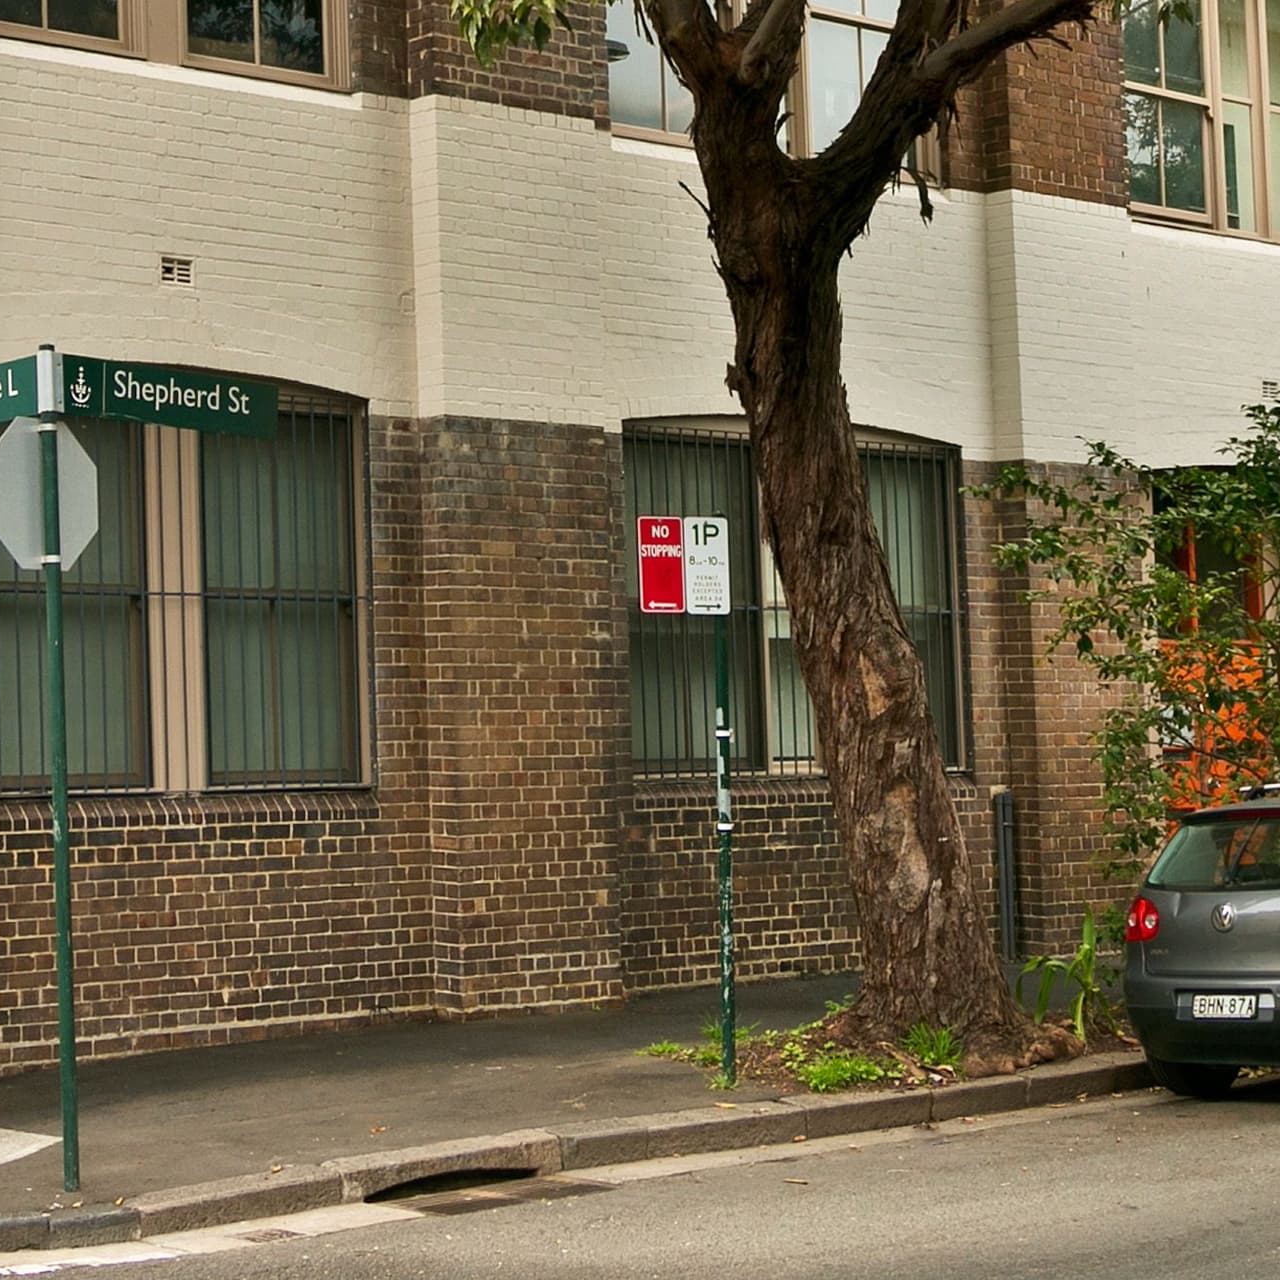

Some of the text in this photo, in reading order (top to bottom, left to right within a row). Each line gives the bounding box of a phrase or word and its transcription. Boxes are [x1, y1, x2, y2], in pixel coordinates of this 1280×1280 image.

[7, 368, 19, 397] L
[113, 370, 250, 415] Shepherd St
[651, 524, 670, 538] NO
[692, 523, 719, 546] 1P
[640, 544, 682, 558] STOPPING
[1199, 997, 1254, 1013] BHN 87A
